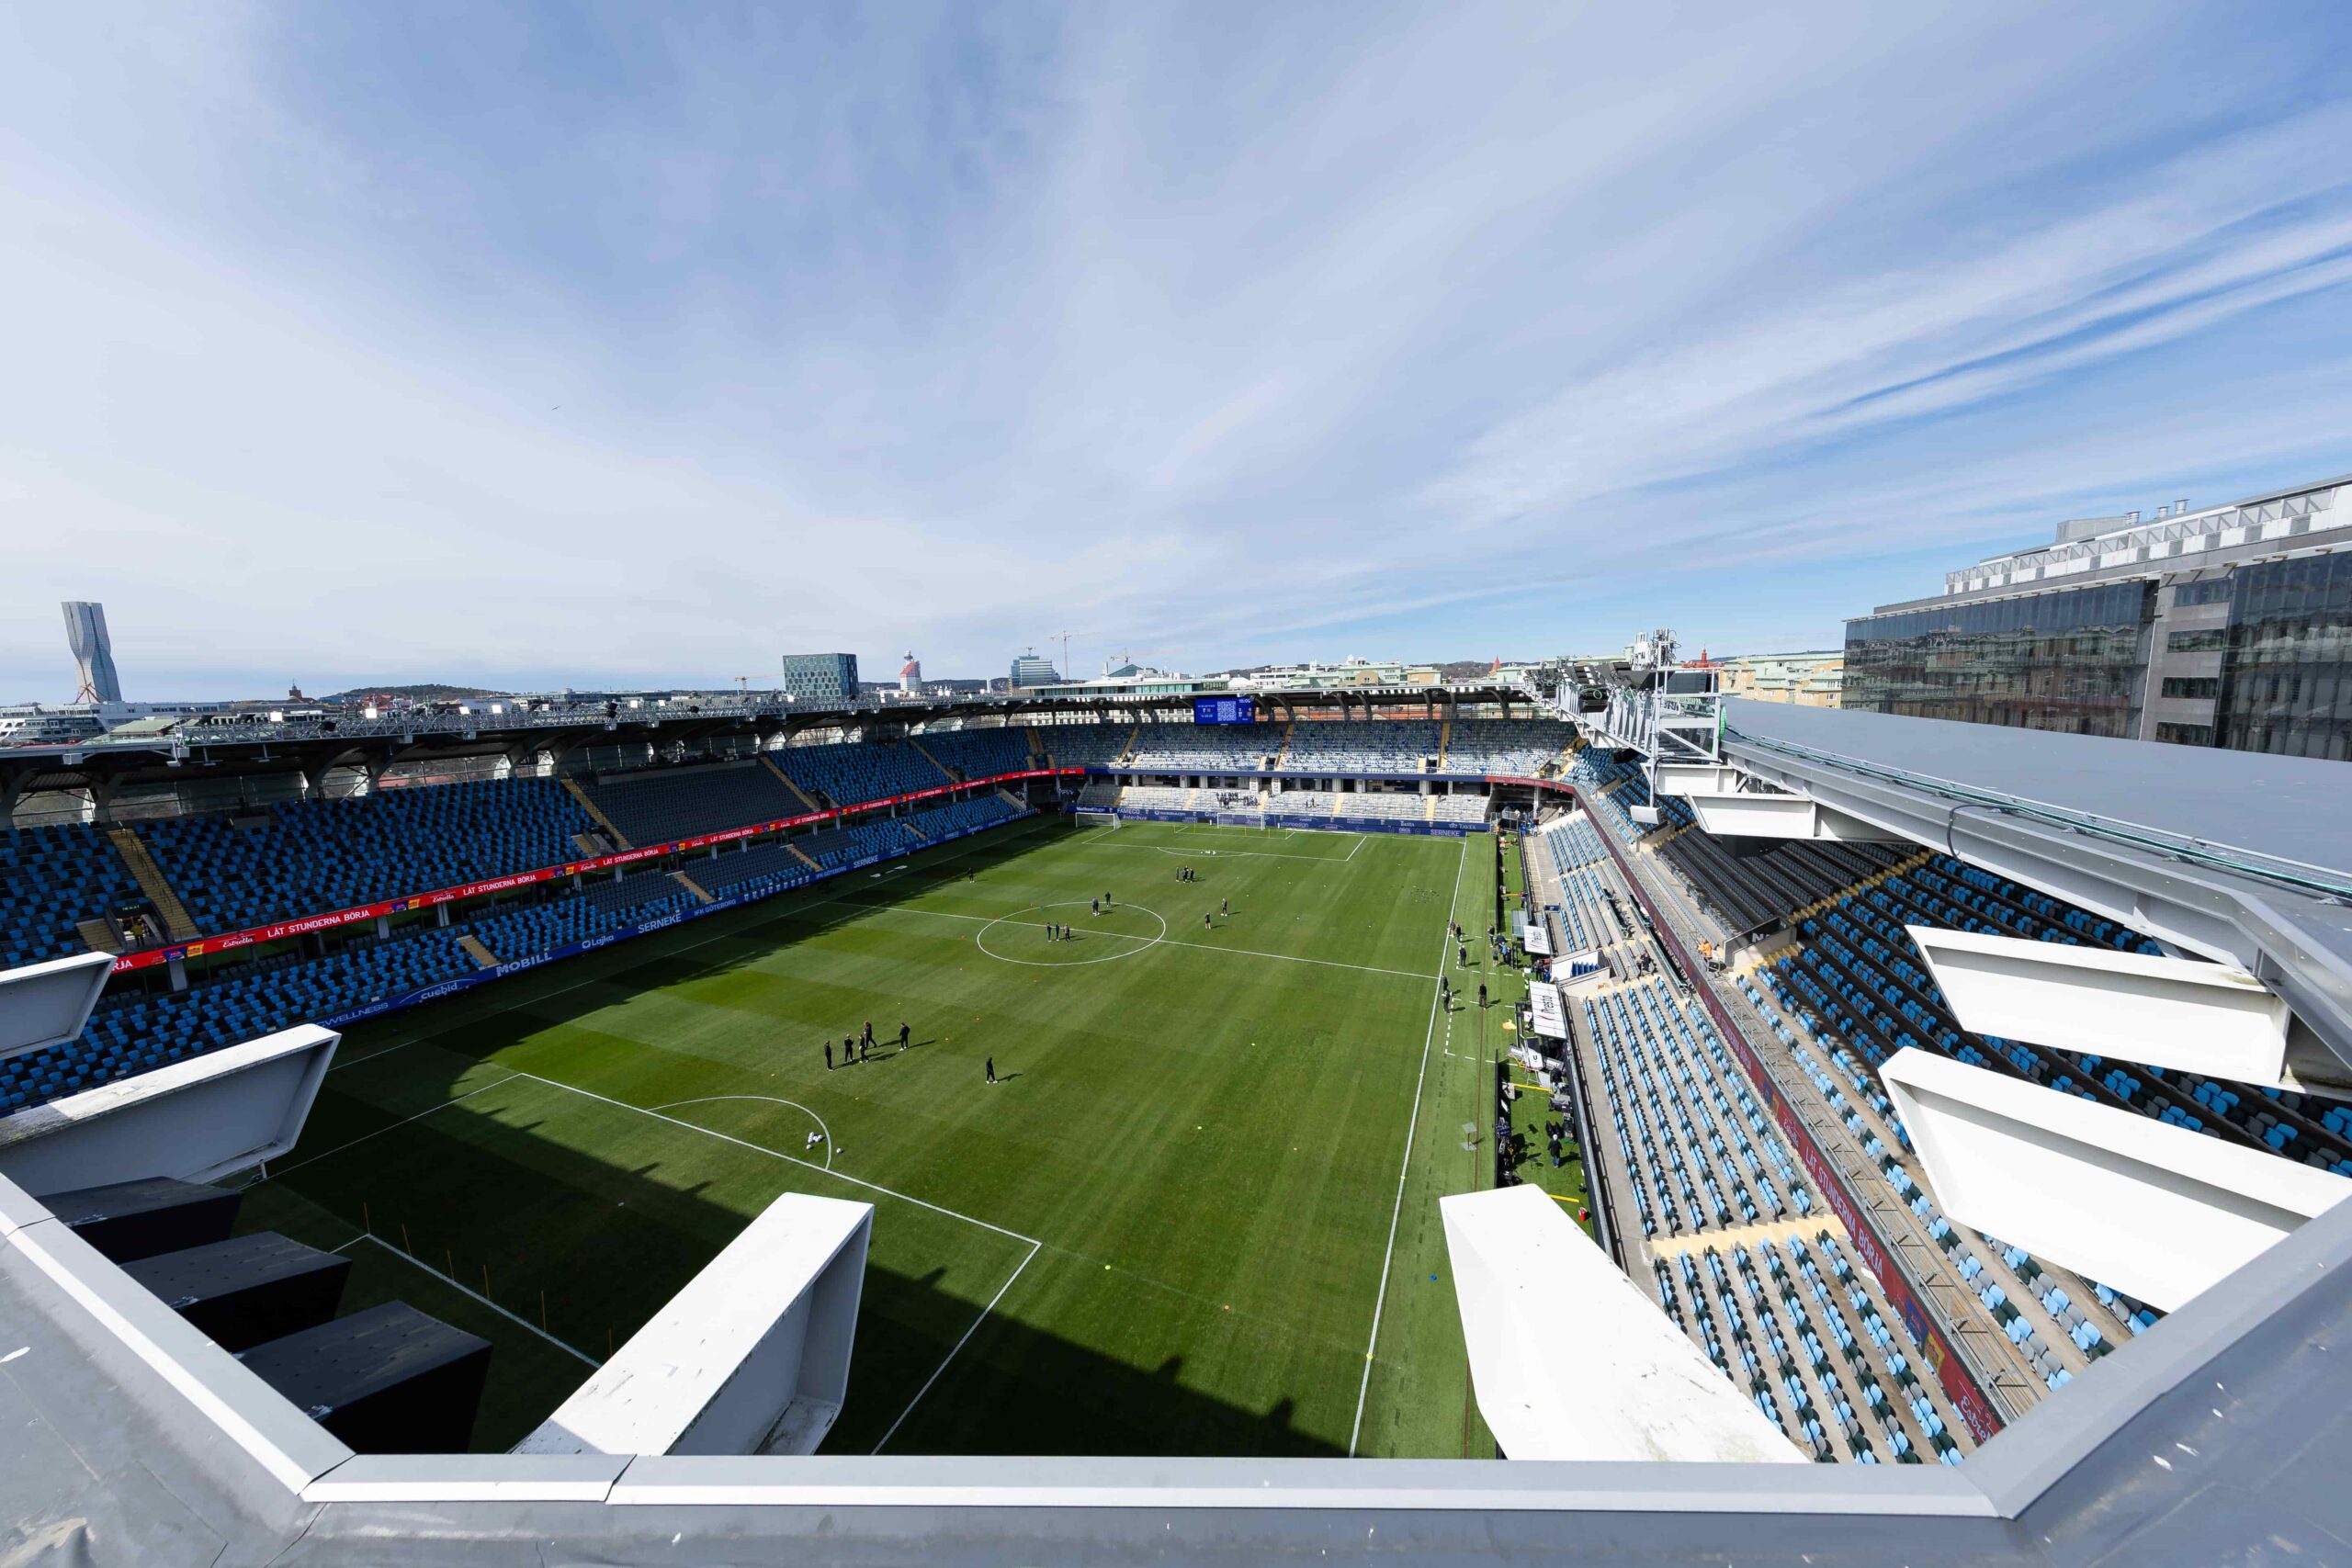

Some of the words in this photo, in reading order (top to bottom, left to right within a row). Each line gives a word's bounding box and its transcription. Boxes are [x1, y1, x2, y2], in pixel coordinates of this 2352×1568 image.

[615, 852, 643, 863] STUNDERNA
[644, 848, 659, 857] BÖRJA
[463, 886, 475, 896] LÅT
[478, 879, 515, 893] STUNDERNA
[517, 874, 537, 885] BÖRJA
[705, 898, 736, 914] GÖTEBORG
[266, 926, 285, 939] LÅT
[288, 916, 342, 933] STUNDERNA
[344, 909, 370, 921] BÖRJA
[638, 913, 682, 933] SERNEKE
[221, 936, 254, 949] Estrella
[592, 934, 615, 946] Lajka
[112, 959, 133, 971] RJA
[496, 953, 552, 976] MOBILL
[421, 983, 458, 1000] cuebid
[1541, 996, 1555, 1014] Presto
[1805, 1145, 1817, 1173] LÅT
[1818, 1167, 1856, 1236] STUNDERNA
[1858, 1226, 1883, 1279] BÖRJA
